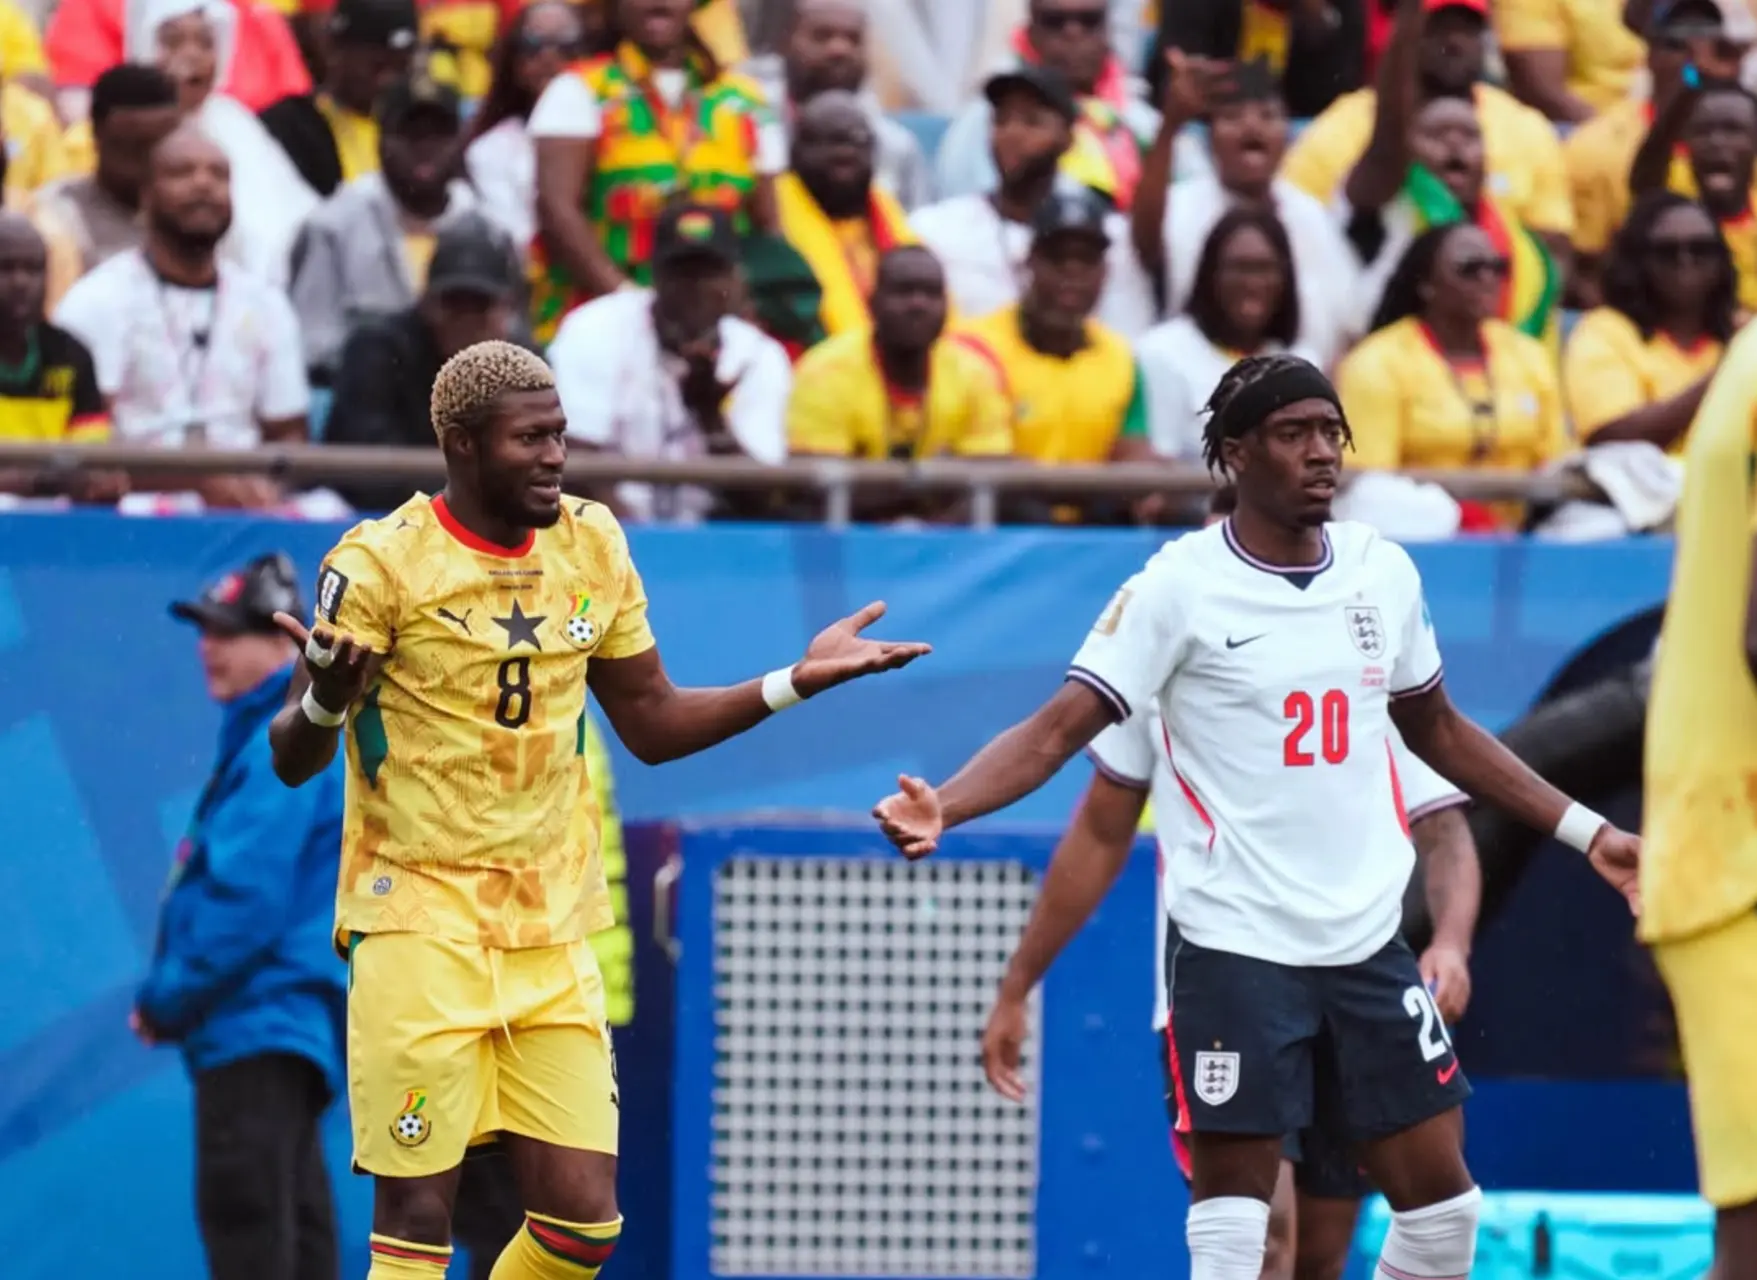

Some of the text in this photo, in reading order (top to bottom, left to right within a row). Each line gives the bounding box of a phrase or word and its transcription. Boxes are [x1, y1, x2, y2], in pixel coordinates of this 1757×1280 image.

[495, 656, 532, 729] 8
[1283, 688, 1349, 767] 20
[1402, 985, 1452, 1062] 2
